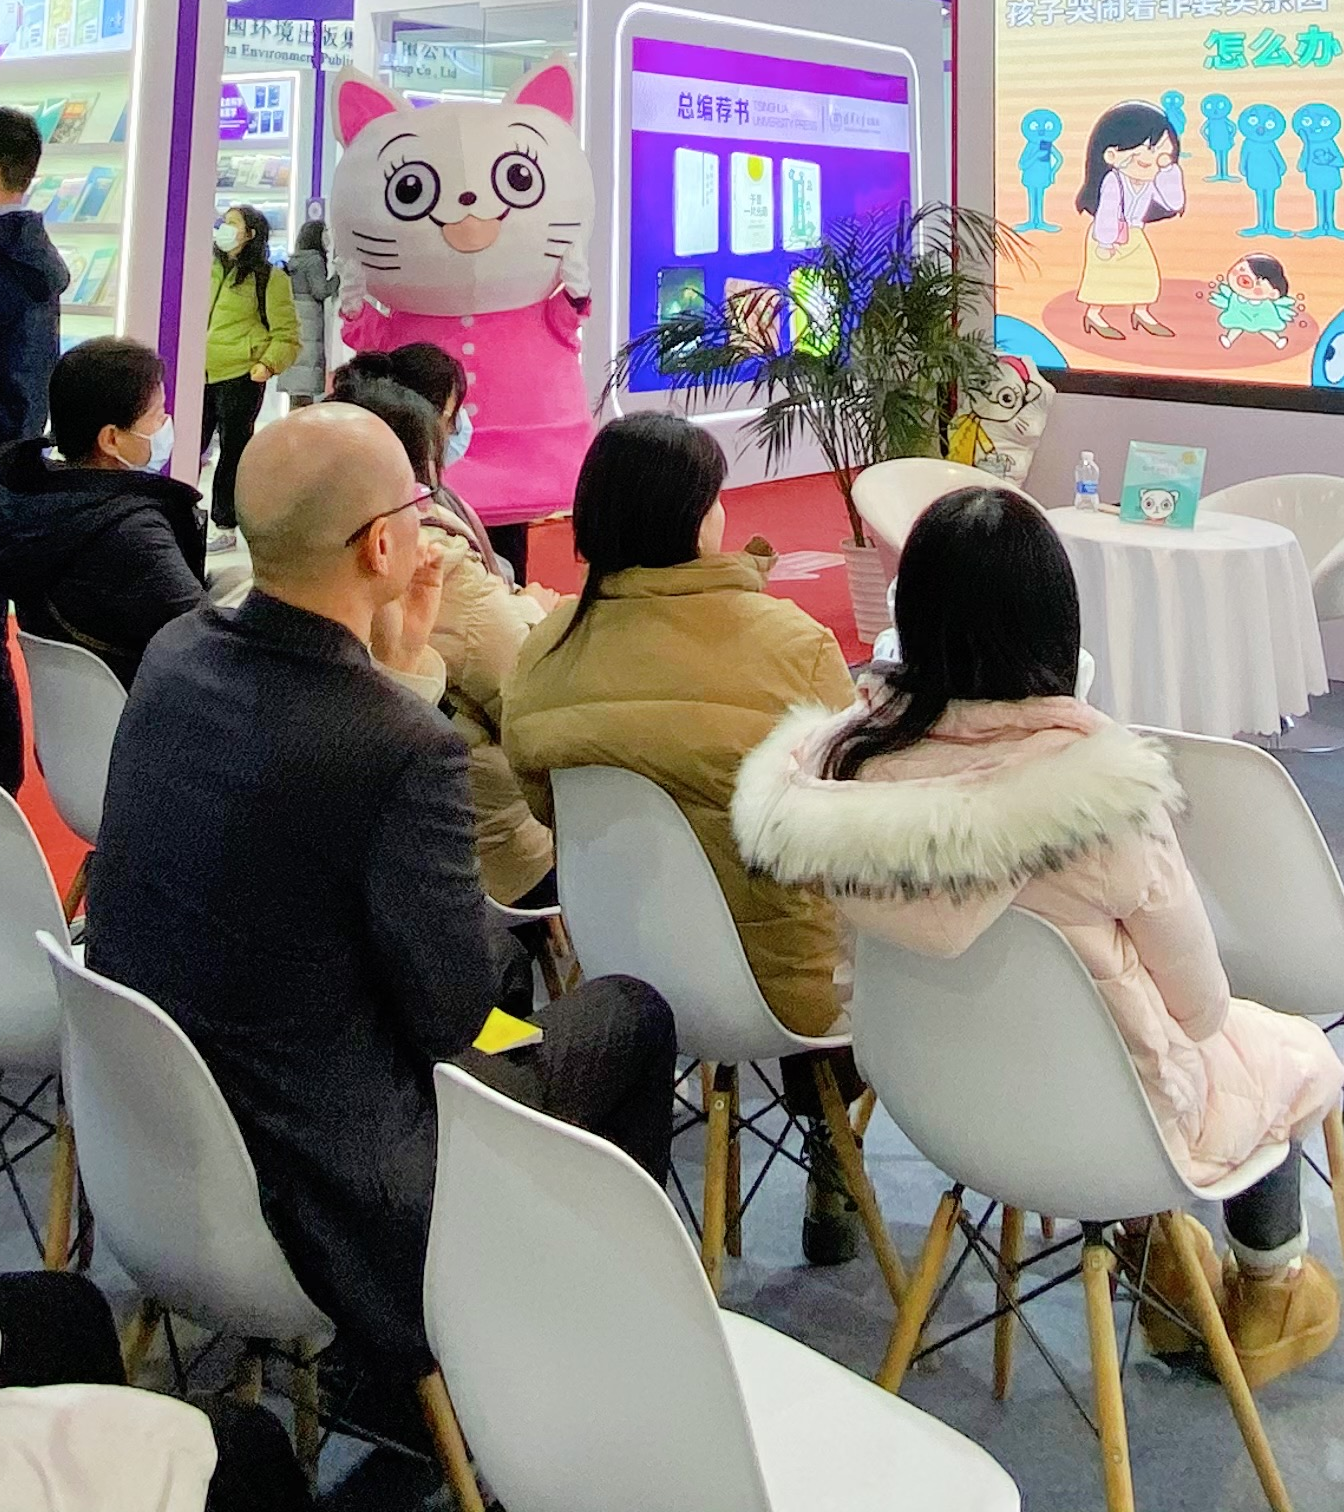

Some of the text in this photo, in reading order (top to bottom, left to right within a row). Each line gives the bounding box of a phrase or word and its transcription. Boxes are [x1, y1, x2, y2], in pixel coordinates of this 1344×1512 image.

[1203, 25, 1343, 71] 怎么办
[677, 91, 750, 126] 总编荐书
